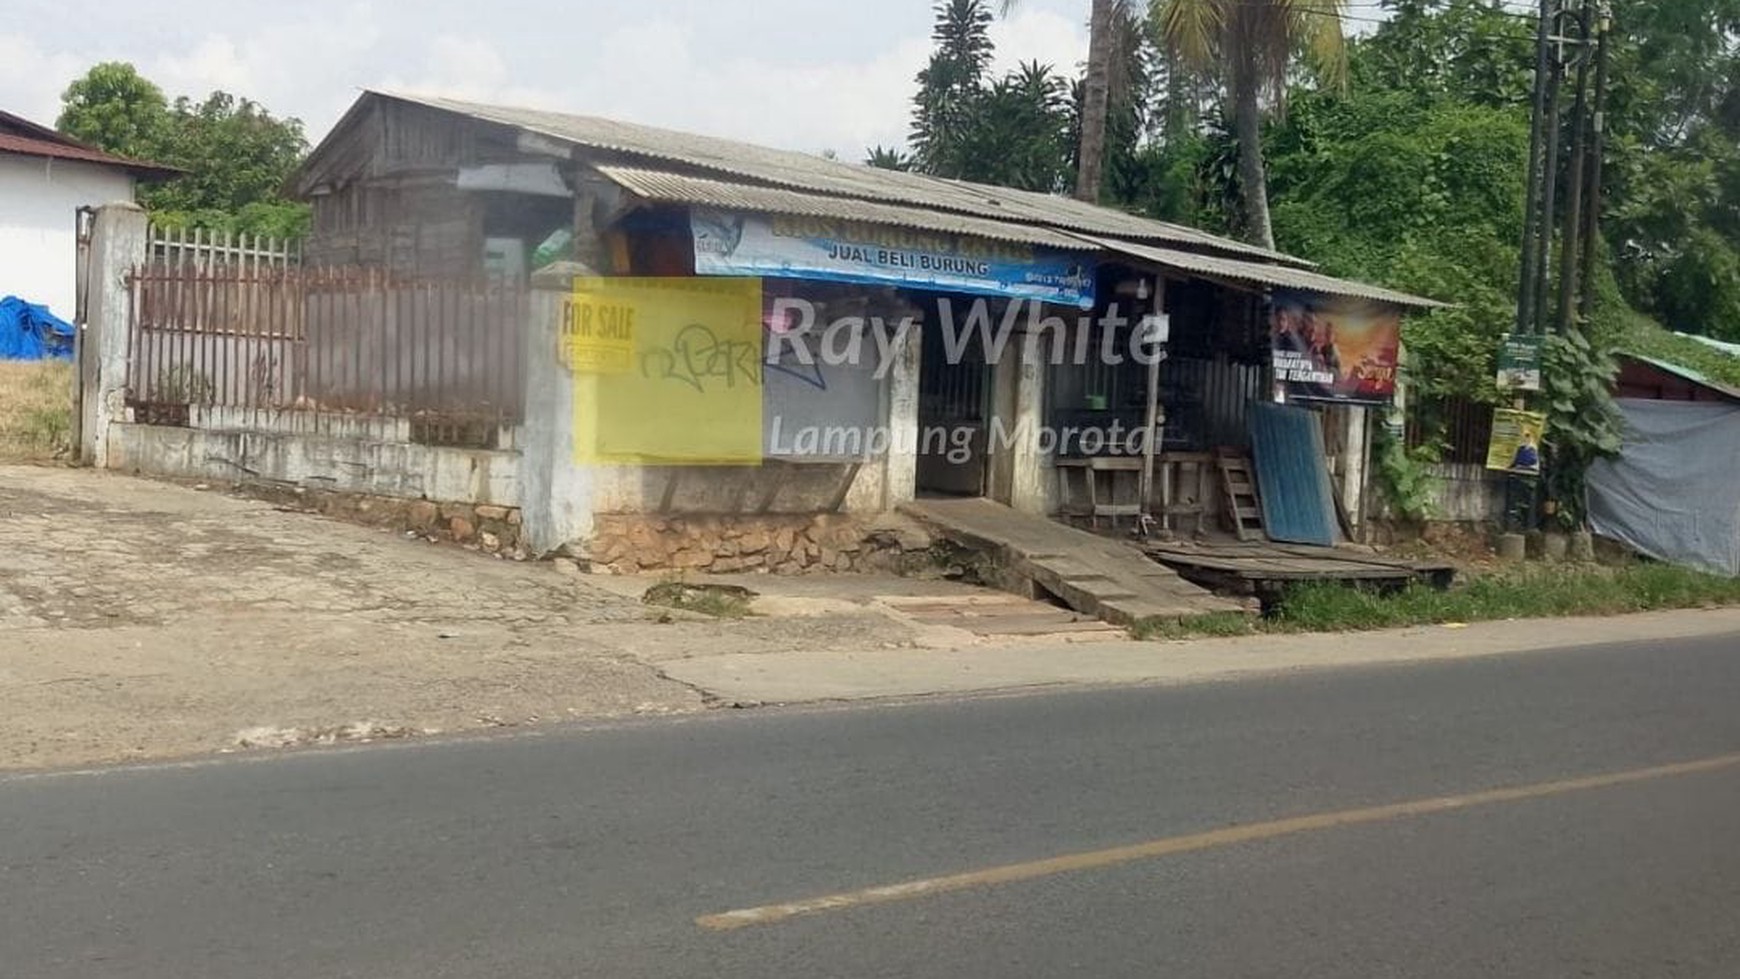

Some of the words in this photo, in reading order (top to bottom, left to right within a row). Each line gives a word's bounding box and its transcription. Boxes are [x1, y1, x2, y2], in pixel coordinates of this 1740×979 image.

[828, 244, 873, 263] JUAL
[878, 250, 915, 268] BELI
[920, 255, 989, 276] BURUNG
[562, 300, 592, 337] FOR
[597, 304, 635, 341] SALE
